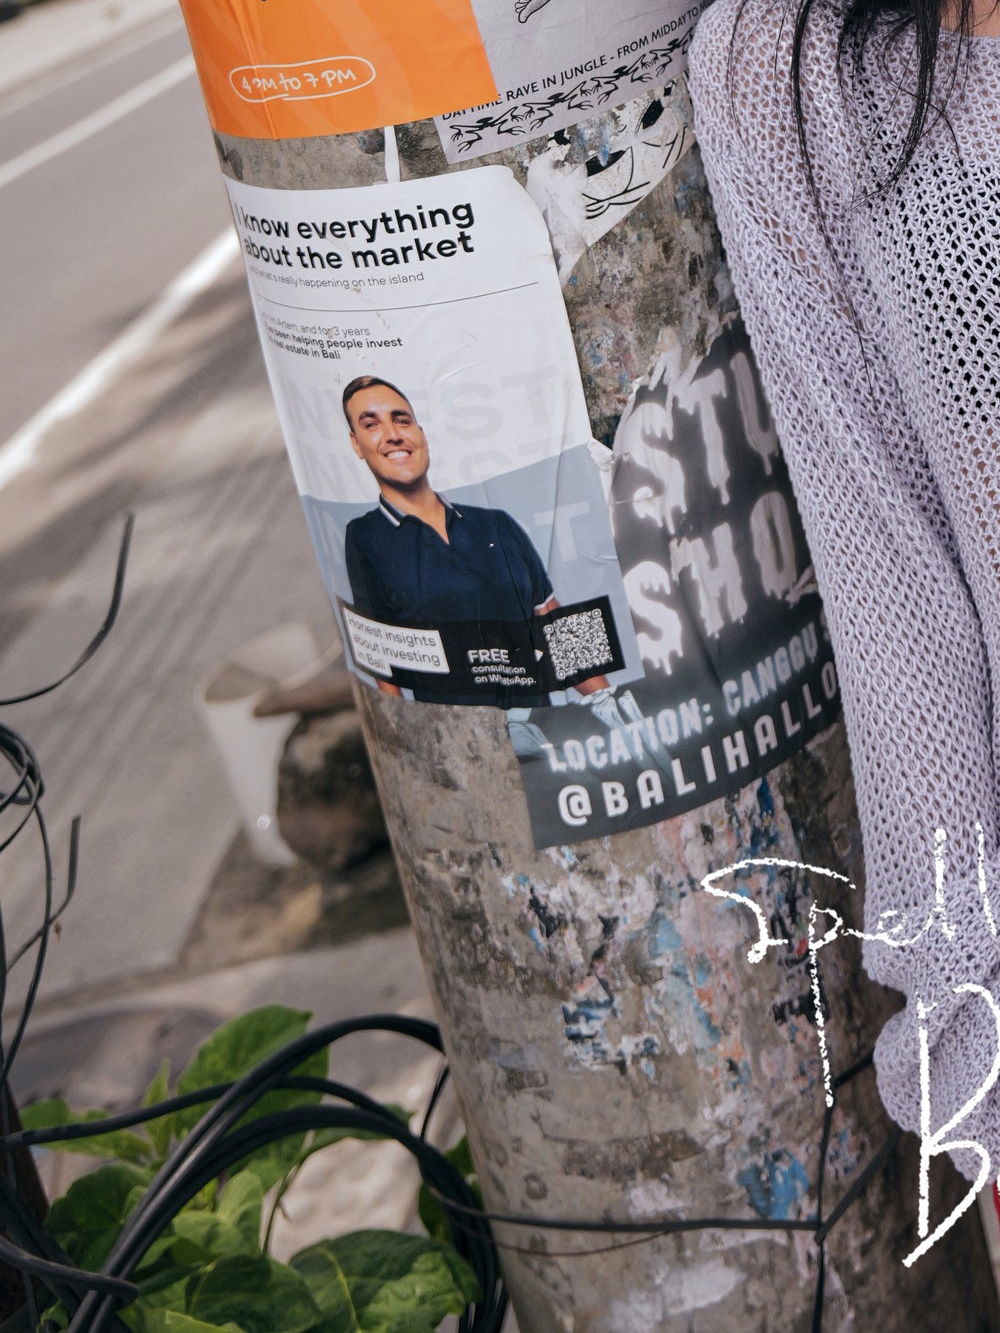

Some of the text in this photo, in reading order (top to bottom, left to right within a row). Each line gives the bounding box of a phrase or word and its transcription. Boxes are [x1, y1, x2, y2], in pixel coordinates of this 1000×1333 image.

[506, 81, 540, 102] RAVE
[542, 74, 557, 89] IN
[559, 54, 608, 86] JUNGLE
[616, 35, 650, 59] FROM
[650, 13, 687, 44] MIDDAY
[687, 6, 699, 21] TO
[279, 72, 302, 91] to
[303, 72, 318, 88] 7
[321, 68, 357, 88] PM
[234, 202, 476, 243] I know everything
[243, 230, 476, 269] about the market
[278, 275, 298, 287] really
[298, 276, 350, 290] happening
[351, 278, 366, 288] on
[368, 276, 387, 287] the
[388, 271, 425, 285] island
[292, 335, 325, 349] helping
[326, 338, 363, 350] people
[366, 337, 403, 349] invest
[301, 325, 317, 335] and
[334, 326, 340, 336] 3
[341, 328, 371, 338] years
[286, 343, 310, 356] estate
[311, 347, 321, 358] in
[322, 349, 341, 360] Bali
[349, 615, 437, 648] Honest insights
[353, 636, 441, 667] about investing
[357, 649, 386, 670] in Bali
[467, 648, 511, 664] FREE
[471, 664, 527, 675] consultation
[474, 675, 489, 683] on
[541, 621, 820, 773] LOCATION: CANGGU
[557, 660, 839, 827] @BALIHALLO
